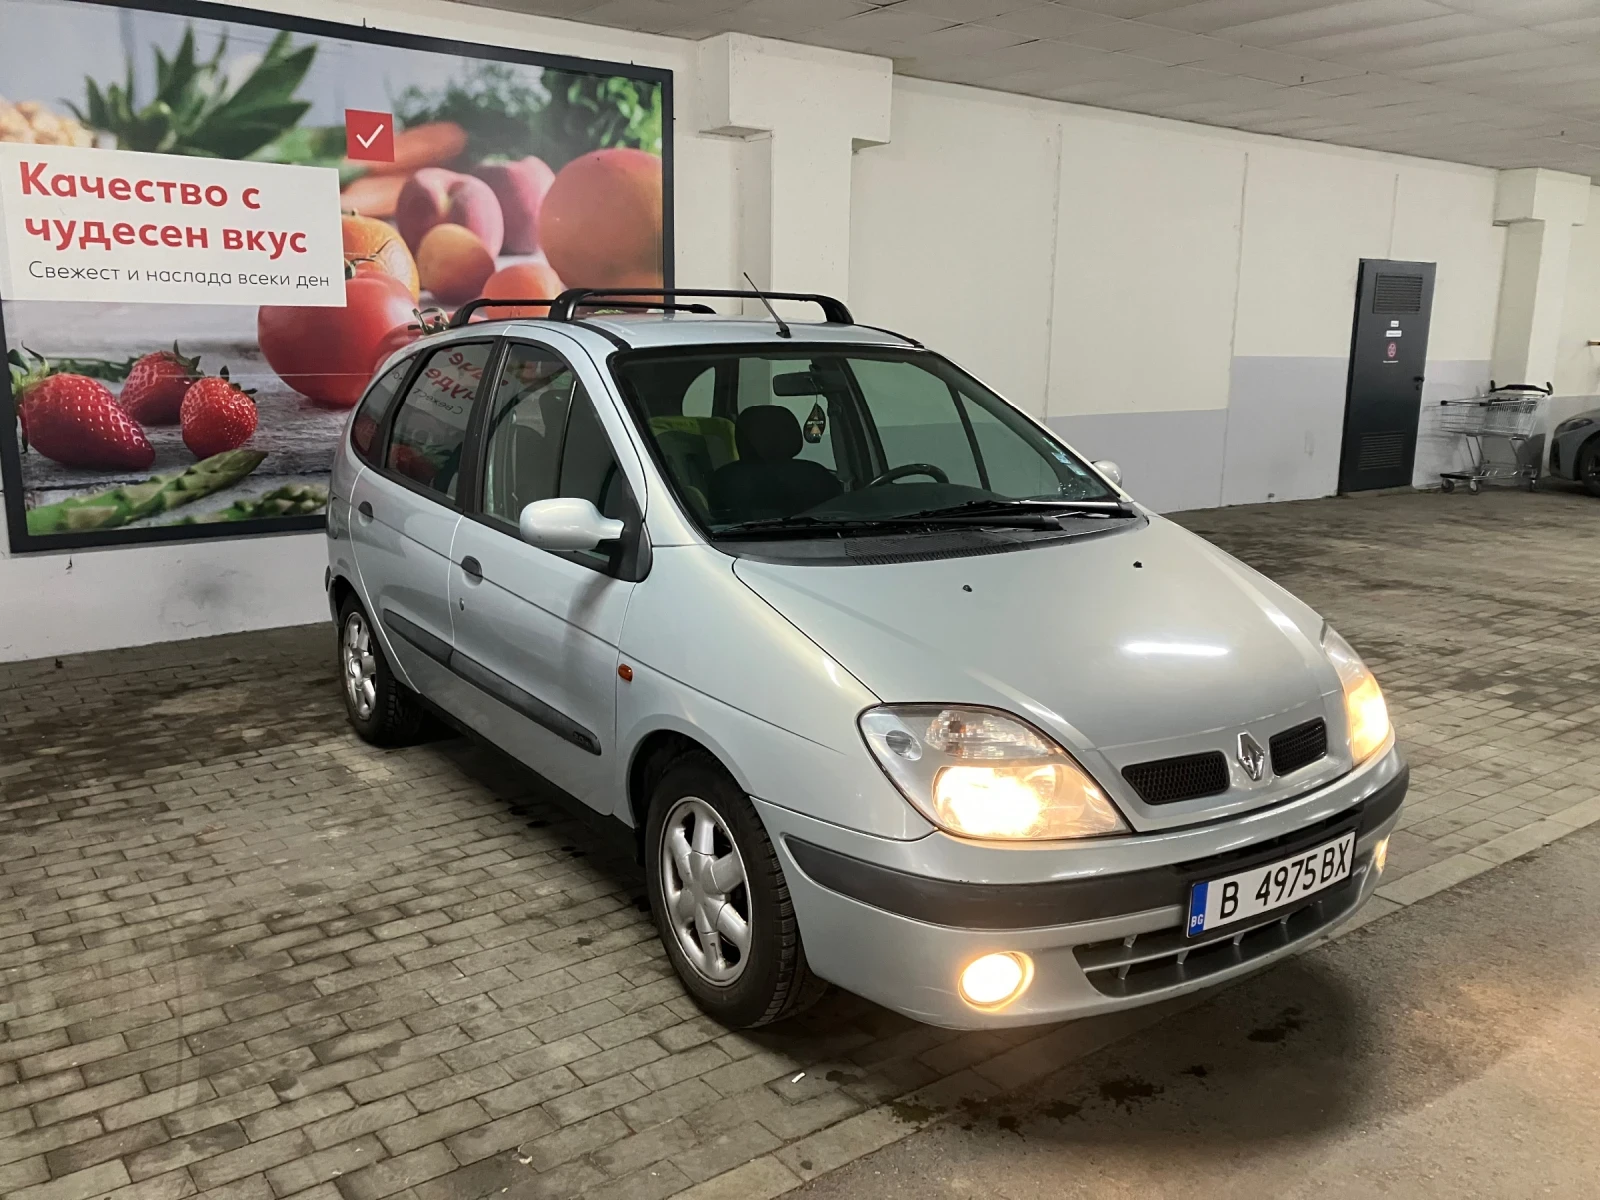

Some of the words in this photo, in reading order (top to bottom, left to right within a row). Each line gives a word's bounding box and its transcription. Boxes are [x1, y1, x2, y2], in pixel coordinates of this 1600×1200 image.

[20, 161, 229, 208] Качество
[241, 187, 261, 210] с
[24, 217, 209, 251] чудесен
[222, 228, 308, 260] вкус
[28, 260, 120, 281] Свежест
[127, 268, 140, 282] и
[146, 270, 232, 287] наслада
[238, 273, 291, 287] всеки
[296, 275, 330, 289] ден
[1190, 914, 1204, 926] BG
[1219, 881, 1239, 920] B
